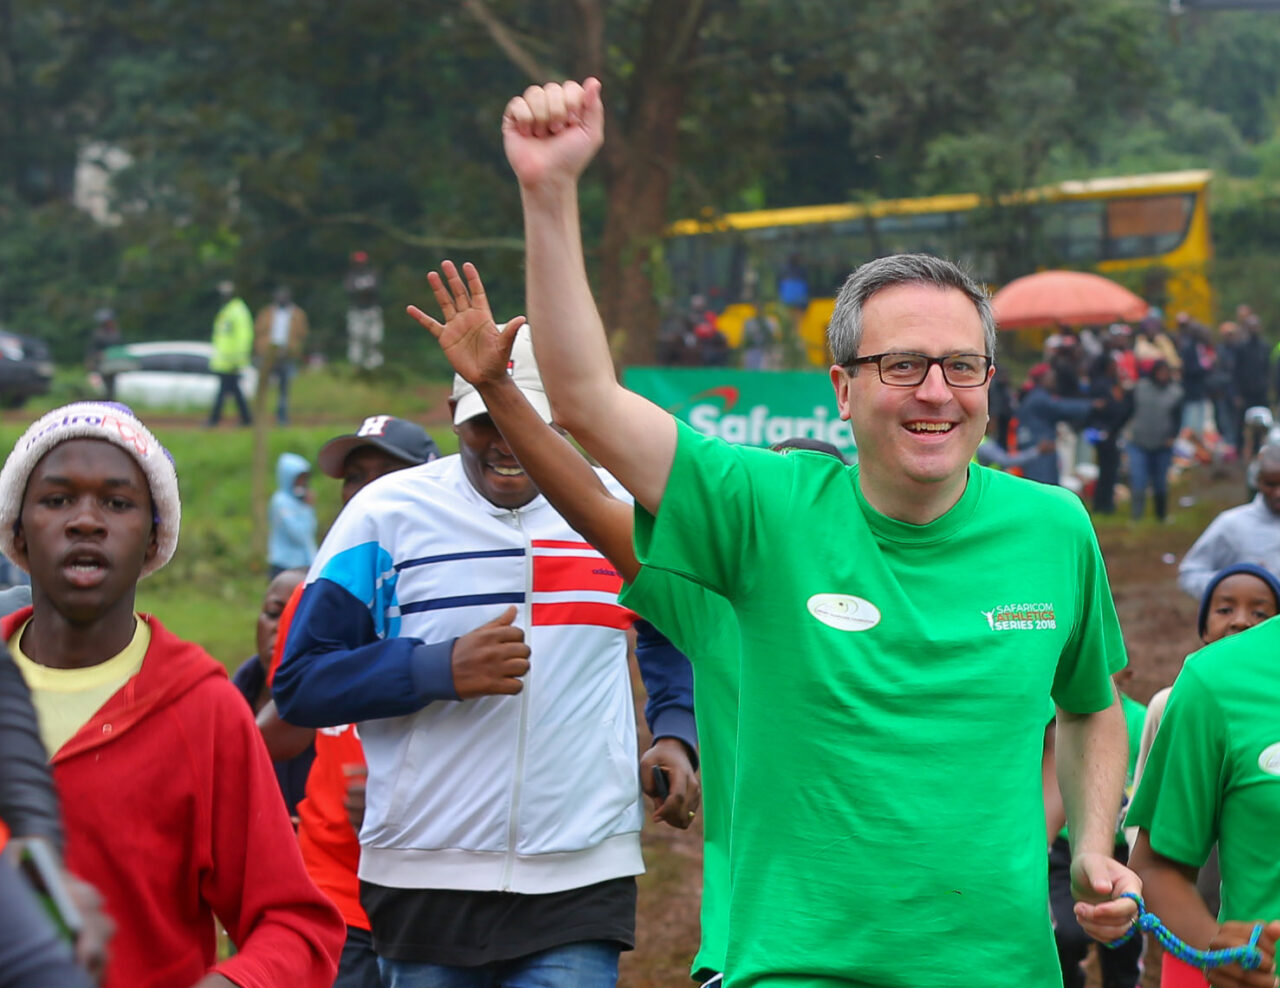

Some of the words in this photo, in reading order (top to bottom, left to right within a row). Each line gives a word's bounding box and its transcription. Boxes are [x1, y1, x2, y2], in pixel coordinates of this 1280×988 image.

[689, 403, 851, 449] Safaric
[996, 603, 1053, 613] SAFARICOM
[997, 611, 1055, 622] ATHLETICS
[995, 620, 1033, 630] SERIES
[1035, 620, 1057, 630] 2018
